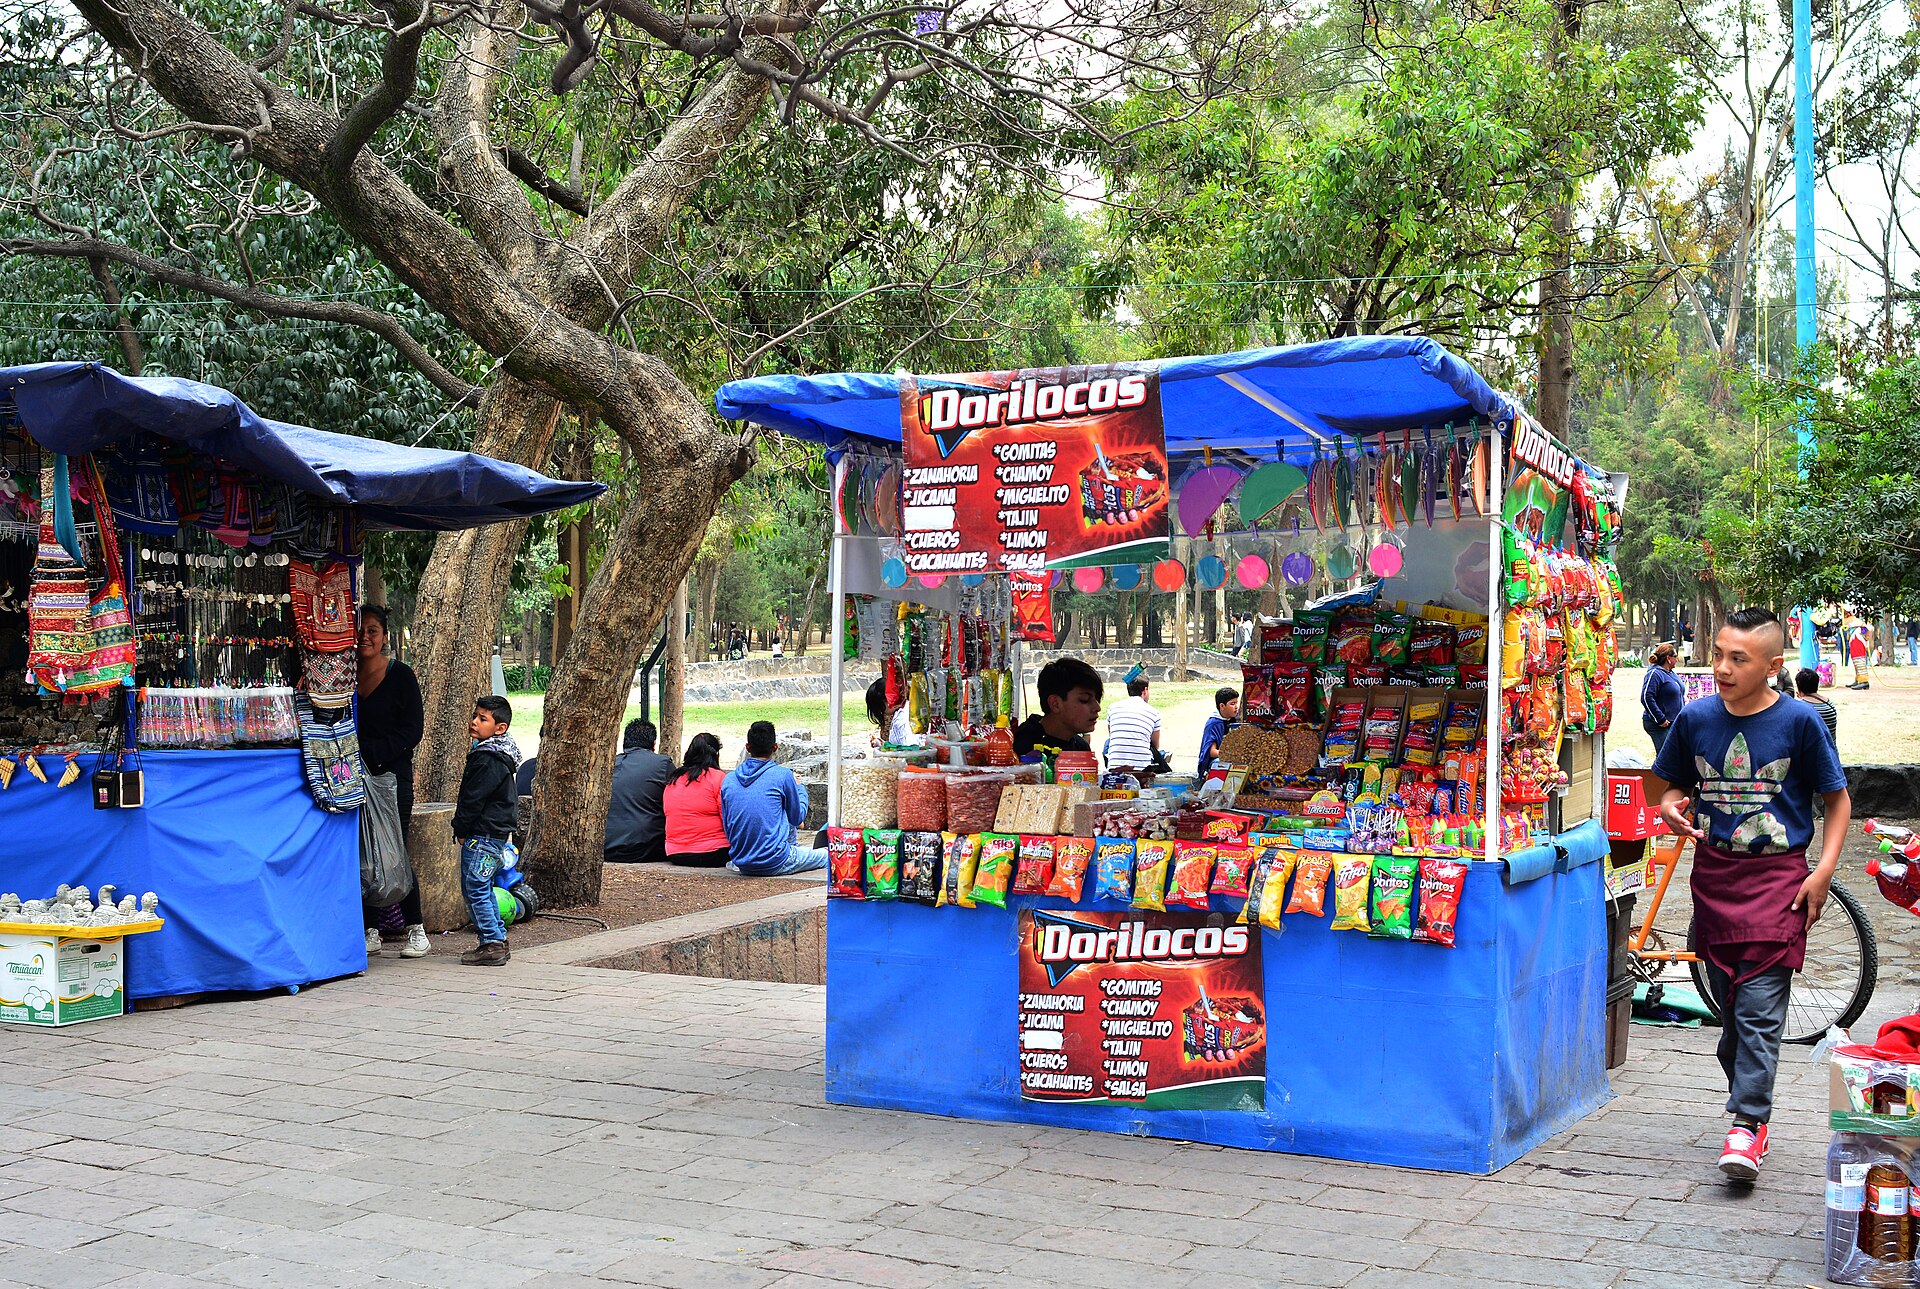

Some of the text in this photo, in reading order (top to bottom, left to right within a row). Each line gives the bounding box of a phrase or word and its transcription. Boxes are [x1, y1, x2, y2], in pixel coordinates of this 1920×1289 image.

[931, 376, 1147, 430] Dorilocos
[1010, 581, 1044, 592] Doritos
[1293, 626, 1325, 636] Doritos
[1457, 628, 1484, 644] Fritos
[1424, 676, 1456, 686] oritos
[1614, 783, 1631, 799] 30
[1308, 804, 1340, 814] Trident
[469, 839, 478, 849] 7
[829, 842, 858, 852] Doritos
[903, 842, 936, 854] Doritos
[1097, 842, 1136, 862] Cheetos
[1137, 848, 1168, 869] Fritos
[1335, 861, 1371, 886] Fritos
[1373, 877, 1410, 890] Doritos
[1419, 879, 1456, 893] Doritos
[1042, 921, 1249, 962] Dorilocos
